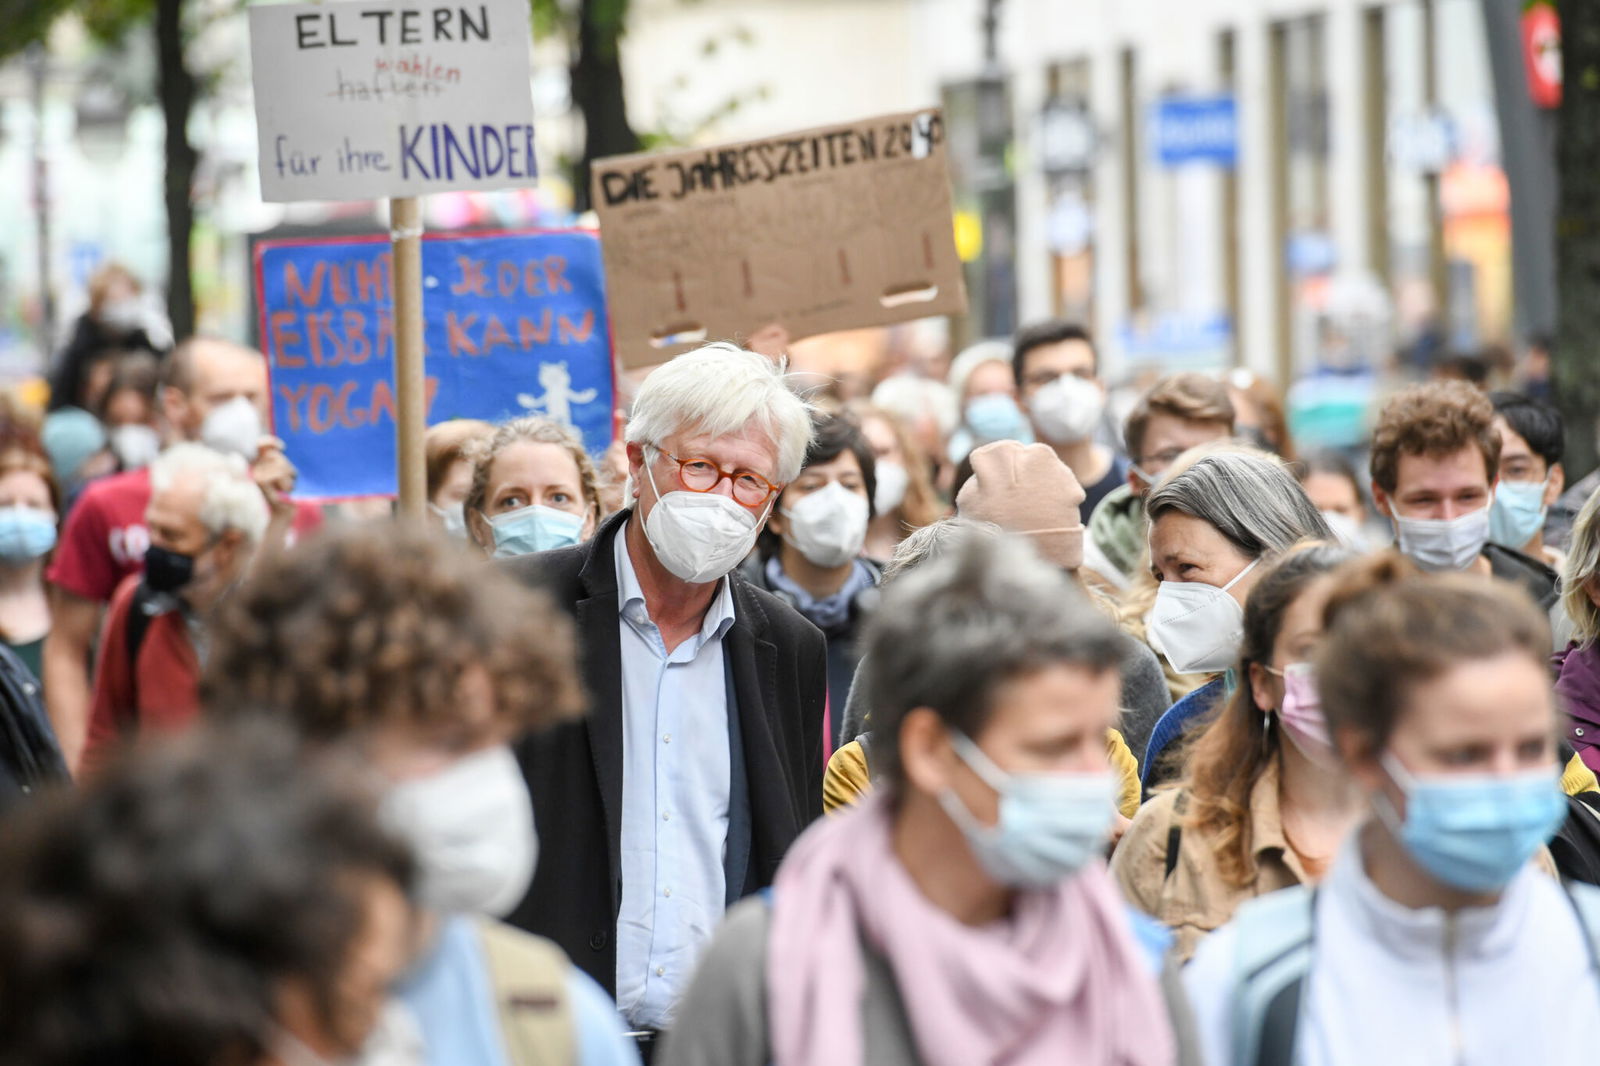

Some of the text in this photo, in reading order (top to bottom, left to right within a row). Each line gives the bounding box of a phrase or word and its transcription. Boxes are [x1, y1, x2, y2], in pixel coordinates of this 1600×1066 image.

[295, 5, 490, 49] ELTERN
[275, 135, 320, 179] für
[338, 137, 391, 174] ihre
[600, 164, 661, 206] DIE
[667, 127, 878, 199] JAHRESZEITEN
[450, 255, 573, 298] JEDER
[446, 308, 596, 357] KANN
